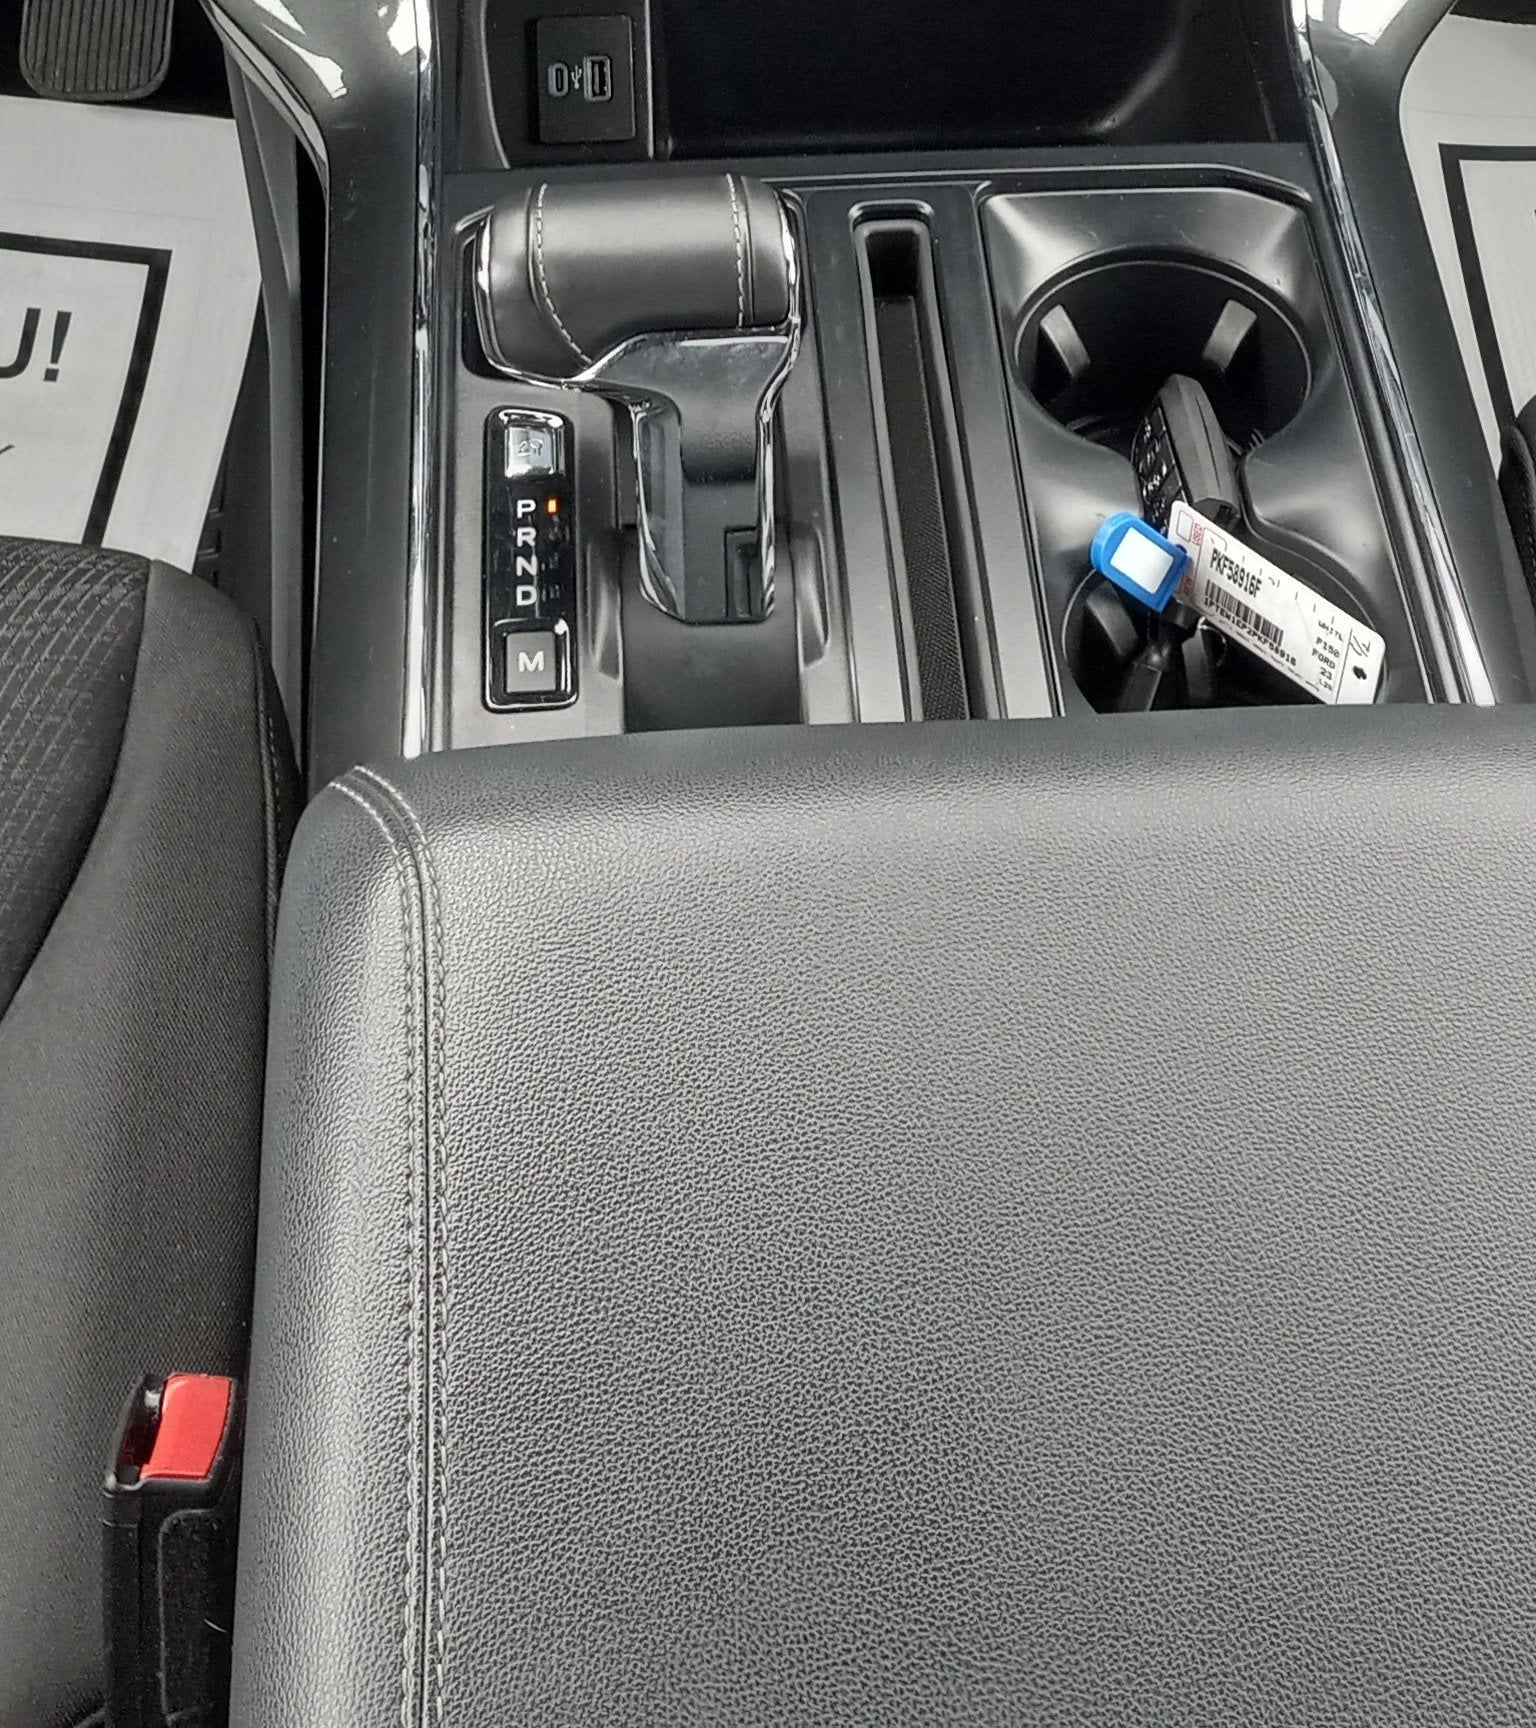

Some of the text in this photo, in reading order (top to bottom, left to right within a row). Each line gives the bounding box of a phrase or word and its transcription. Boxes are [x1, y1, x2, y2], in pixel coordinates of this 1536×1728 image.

[516, 500, 537, 518] P
[516, 527, 537, 547] R
[516, 556, 538, 576] N
[1209, 548, 1263, 598] PKF58916F
[516, 585, 538, 606] D
[518, 651, 545, 672] M
[1312, 648, 1337, 670] FORD
